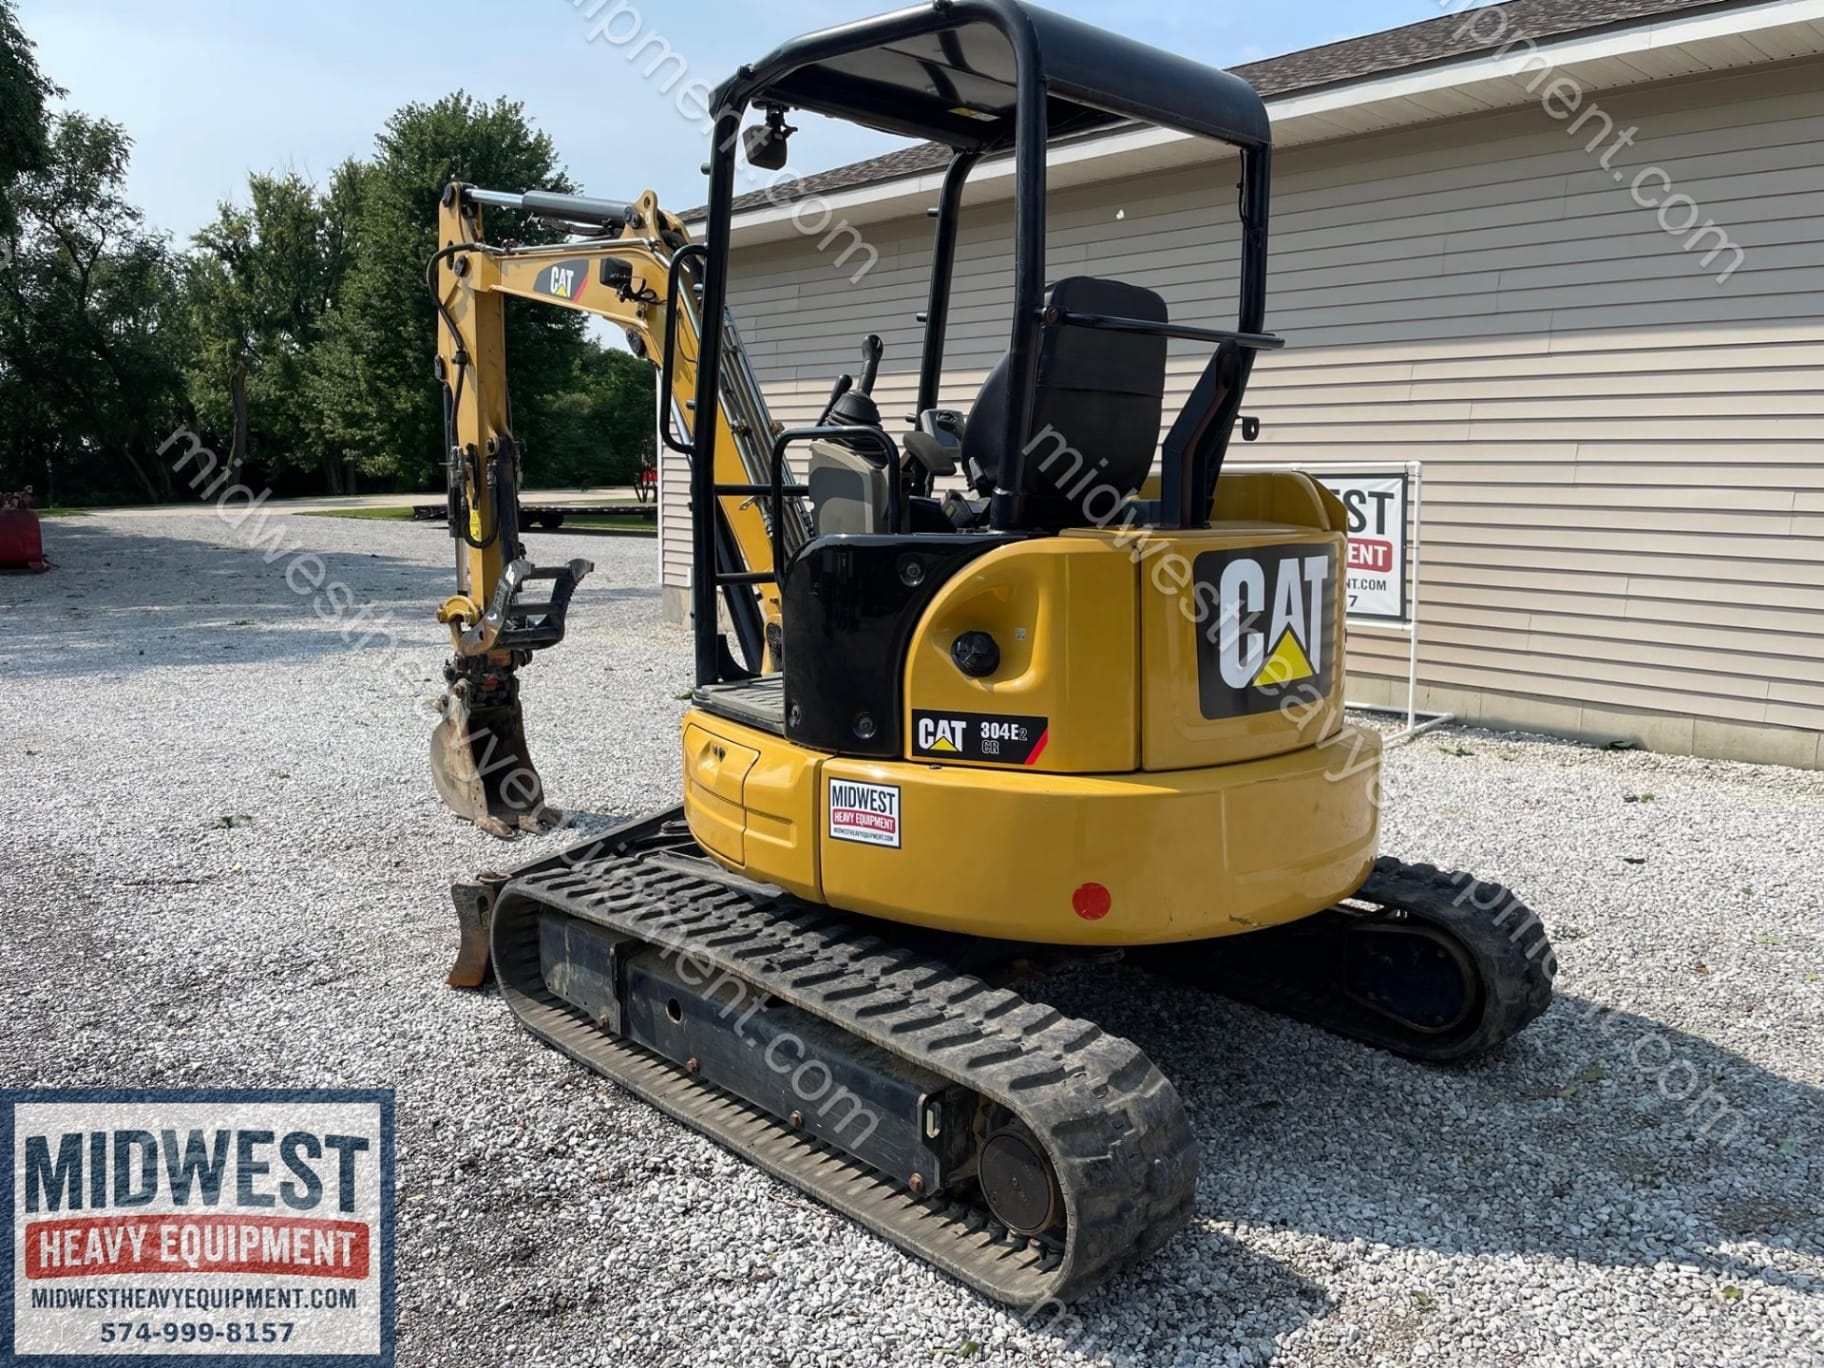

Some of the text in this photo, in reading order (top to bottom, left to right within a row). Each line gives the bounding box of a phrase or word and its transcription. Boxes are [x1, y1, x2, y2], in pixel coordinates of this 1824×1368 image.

[550, 266, 574, 298] CAT
[1331, 489, 1394, 535] ST
[1220, 555, 1328, 689] CAT
[919, 718, 1027, 752] CAT 304E2
[982, 740, 999, 754] CR
[832, 786, 895, 815] MIDWEST
[834, 812, 894, 831] HEAVY EQUIPMENT
